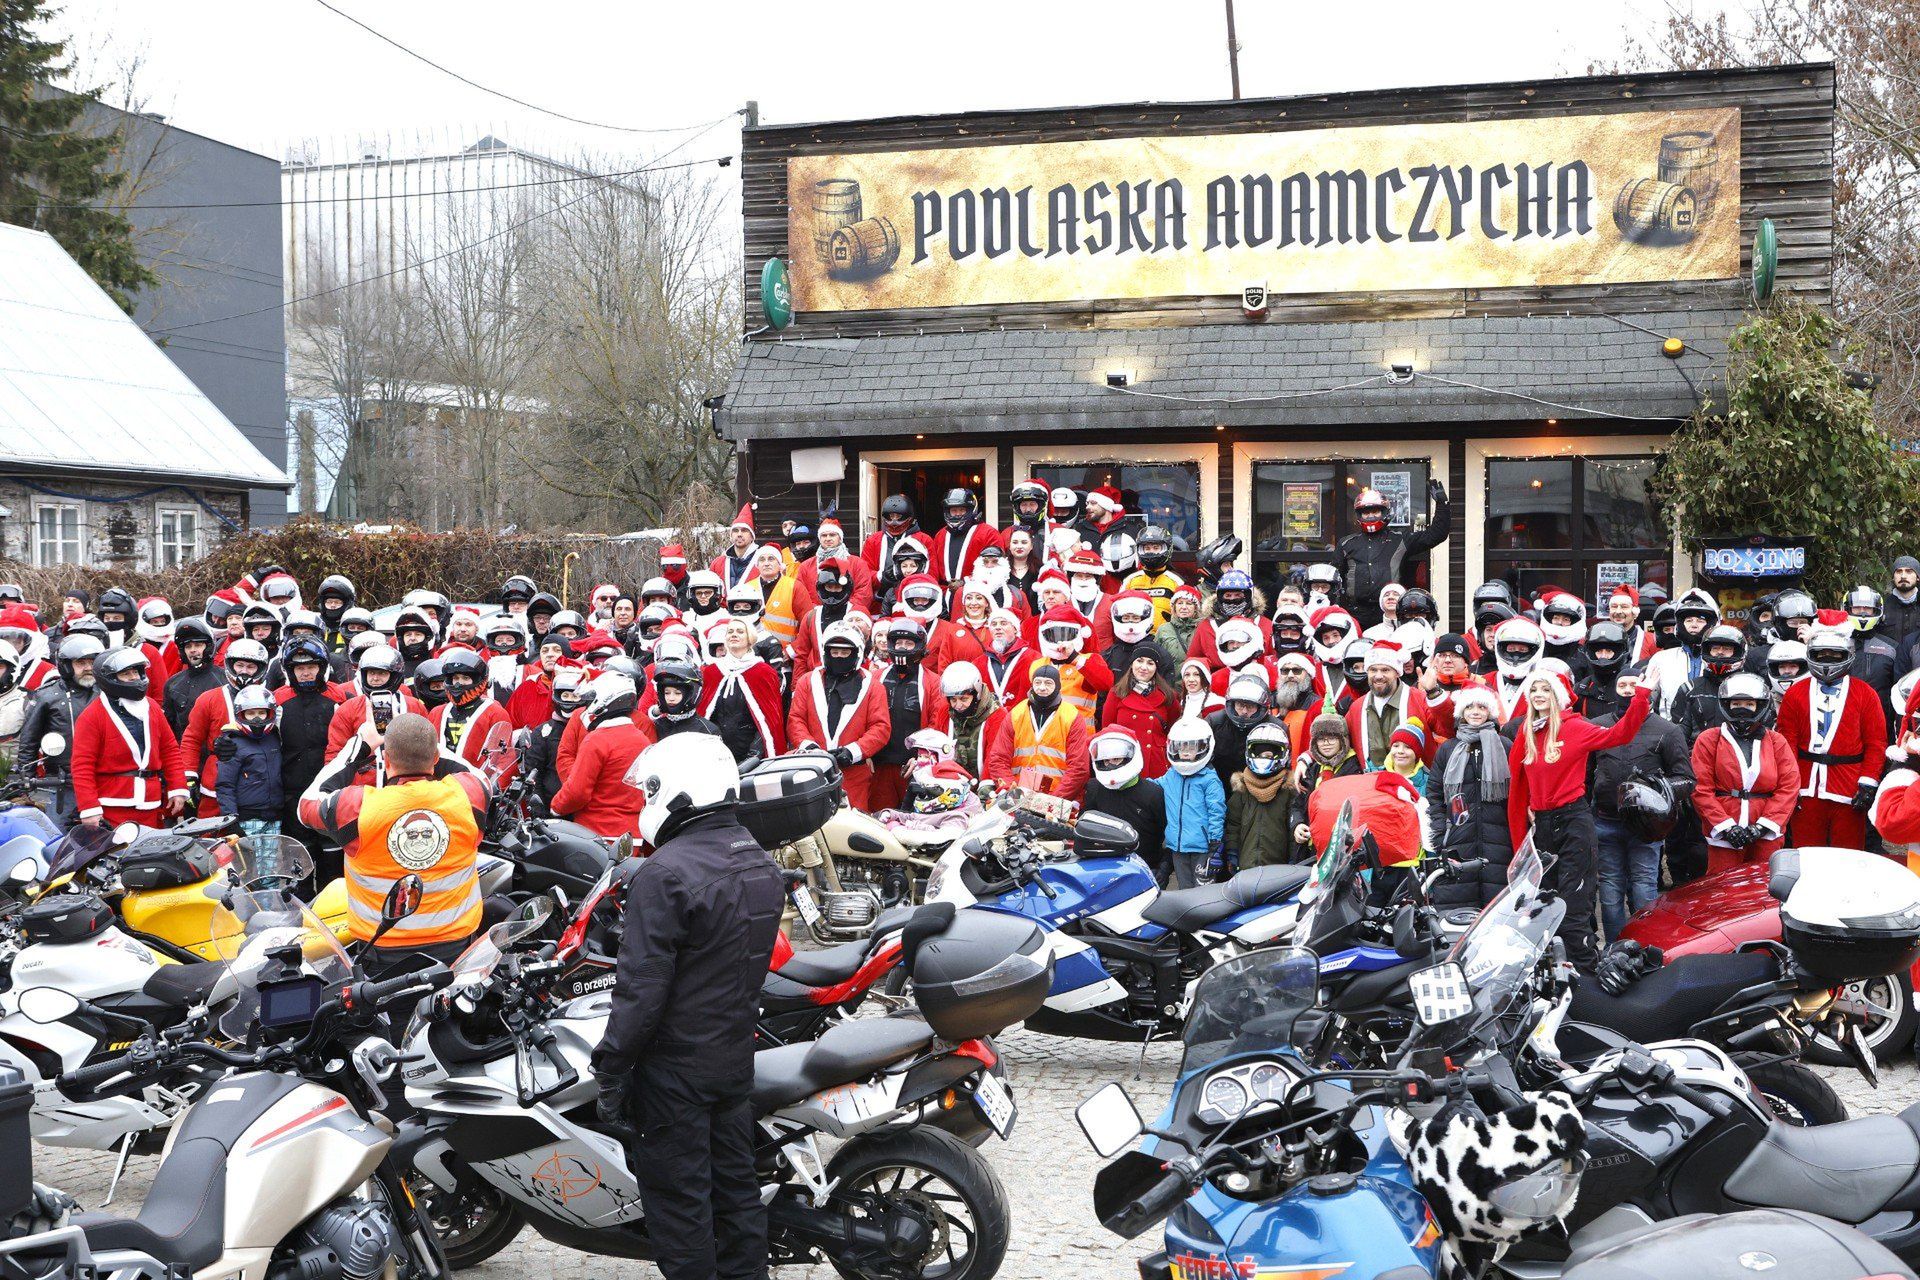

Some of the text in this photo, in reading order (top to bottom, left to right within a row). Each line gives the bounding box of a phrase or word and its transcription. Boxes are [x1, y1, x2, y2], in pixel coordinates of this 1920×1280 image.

[911, 159, 1594, 265] PODLASKA ADAMCZYCHA
[1705, 547, 1805, 573] BOXING
[22, 960, 44, 969] DUCATI
[584, 975, 617, 993] przepis
